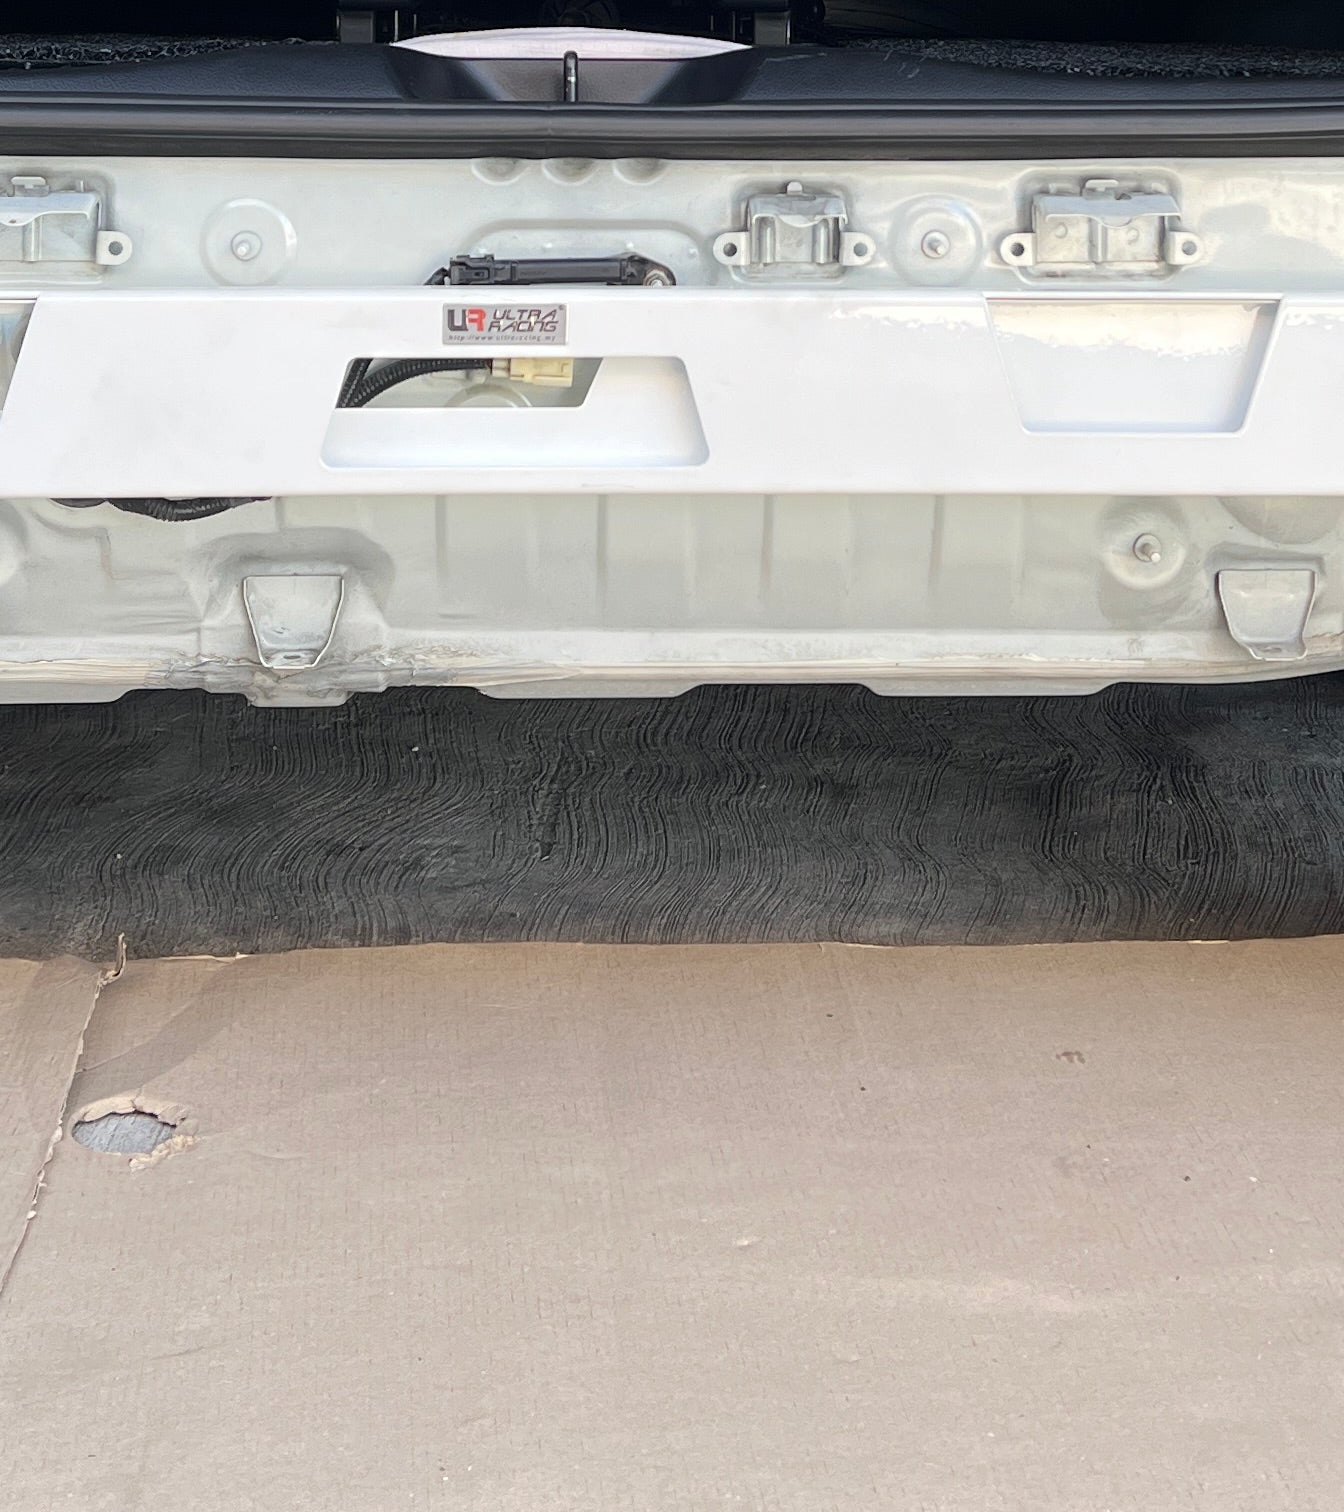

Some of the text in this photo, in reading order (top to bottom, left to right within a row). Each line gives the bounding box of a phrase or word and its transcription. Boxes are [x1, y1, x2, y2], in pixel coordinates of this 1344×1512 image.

[447, 308, 486, 332] UR
[492, 308, 557, 321] ULTRA
[487, 320, 559, 333] RACING
